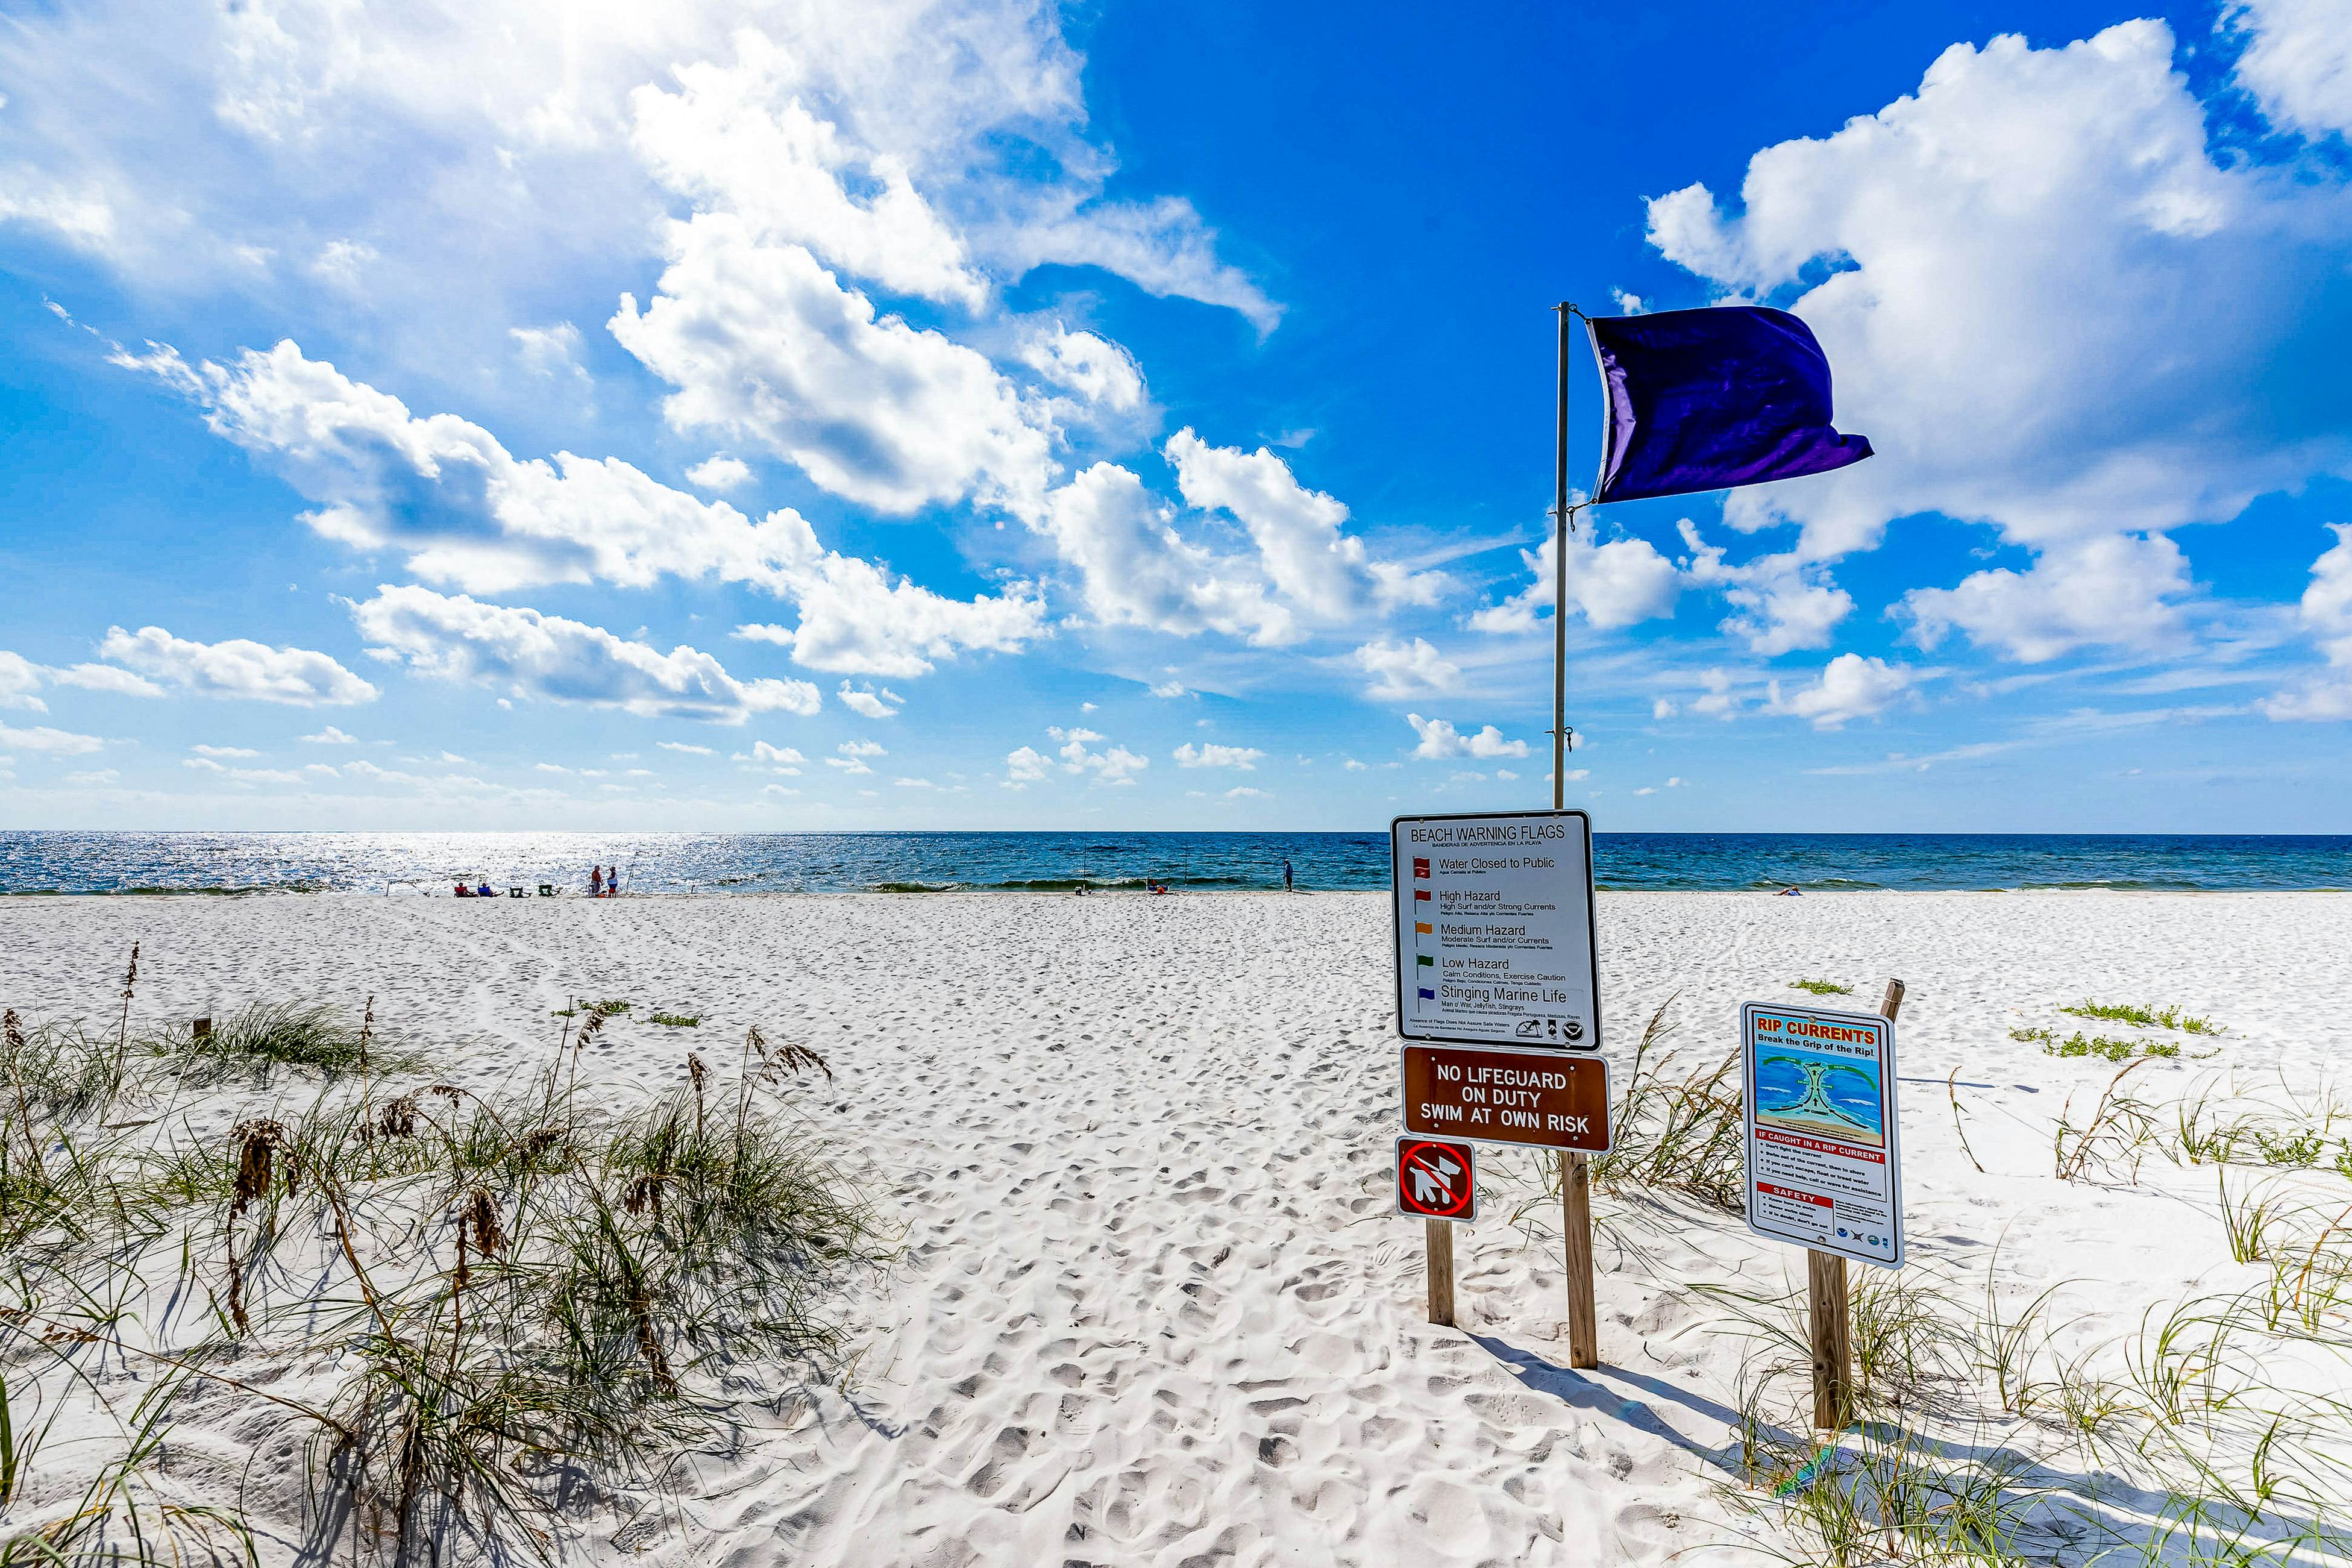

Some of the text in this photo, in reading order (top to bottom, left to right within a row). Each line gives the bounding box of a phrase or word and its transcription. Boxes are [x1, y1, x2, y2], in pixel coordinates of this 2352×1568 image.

[1411, 824, 1565, 842] BEACH WARNING FLAGS
[1439, 857, 1555, 869] Water Closed to Public
[1440, 890, 1501, 903] High Hazard
[1441, 924, 1525, 935] Medium Hazard
[1442, 957, 1509, 969] Low Hazard
[1441, 985, 1567, 1003] Stinging Marine Life
[1498, 1003, 1525, 1011] Stingrays
[1757, 1017, 1875, 1045] RIP CURRENTS
[1758, 1033, 1783, 1044] Break
[1786, 1037, 1800, 1046] the
[1802, 1040, 1822, 1050] Grip
[1836, 1044, 1852, 1053] the
[1855, 1046, 1875, 1057] Rip!
[1437, 1065, 1566, 1090] NO LIFEGUARD
[1461, 1087, 1541, 1108] ON DUTY
[1420, 1103, 1590, 1134] SWIM AT OWN RISK
[1768, 1133, 1801, 1145] CAUGHT
[1839, 1147, 1880, 1161] CURRENT
[1773, 1187, 1815, 1202] SAFETY
[1851, 1187, 1881, 1196] assistance
